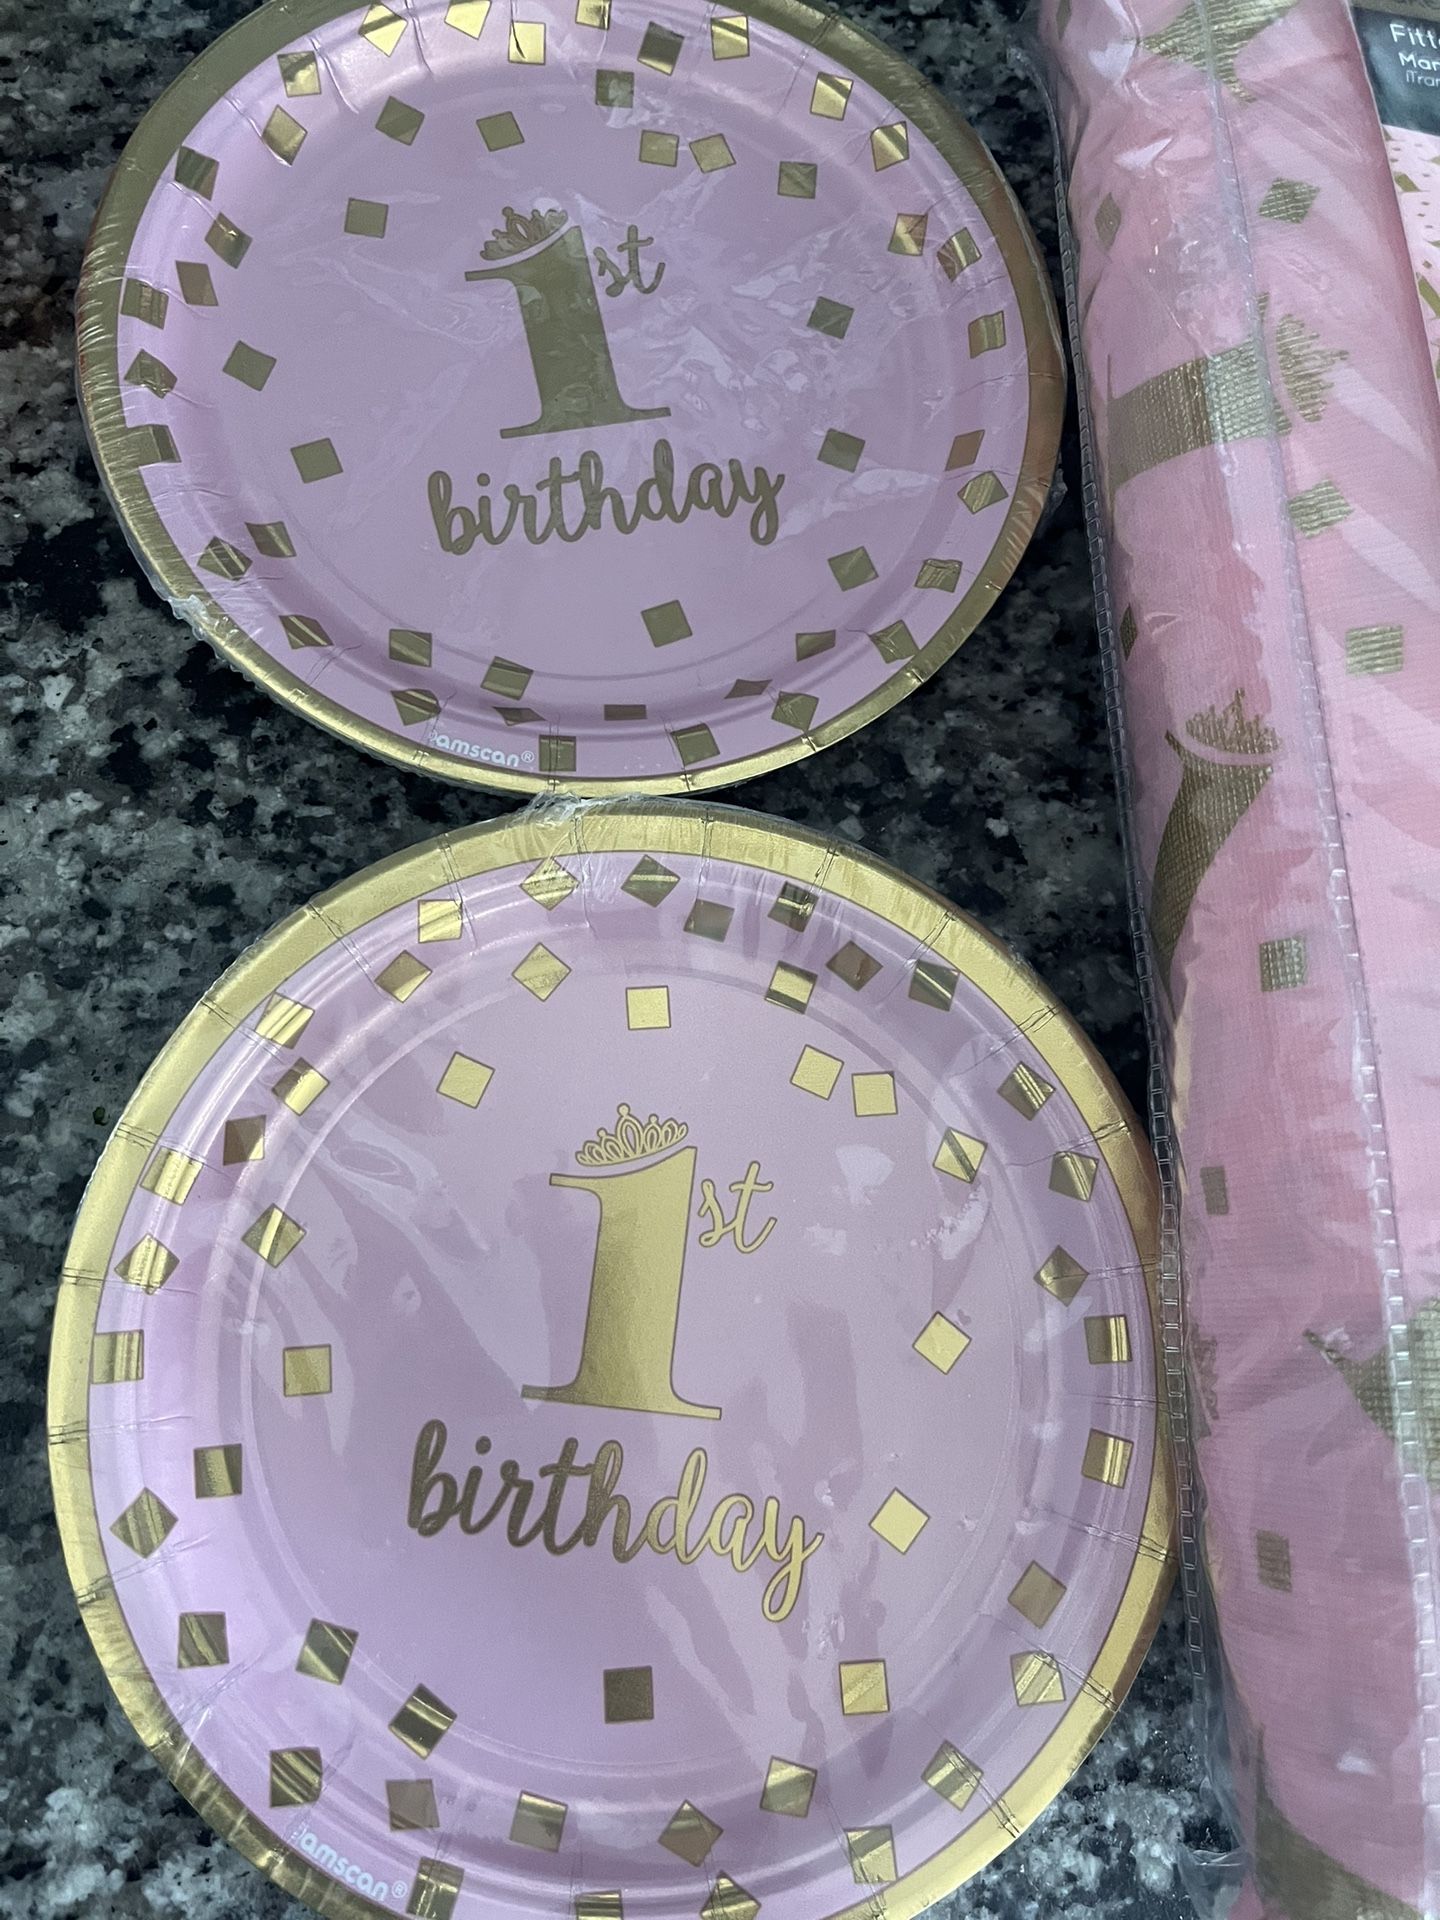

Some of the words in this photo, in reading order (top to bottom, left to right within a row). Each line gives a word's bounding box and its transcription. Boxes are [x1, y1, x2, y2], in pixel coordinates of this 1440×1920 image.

[1389, 23, 1440, 49] Fitt
[463, 224, 672, 440] 1st
[426, 438, 786, 556] birthday
[520, 1145, 778, 1421] 1st
[406, 1418, 825, 1623] birthday
